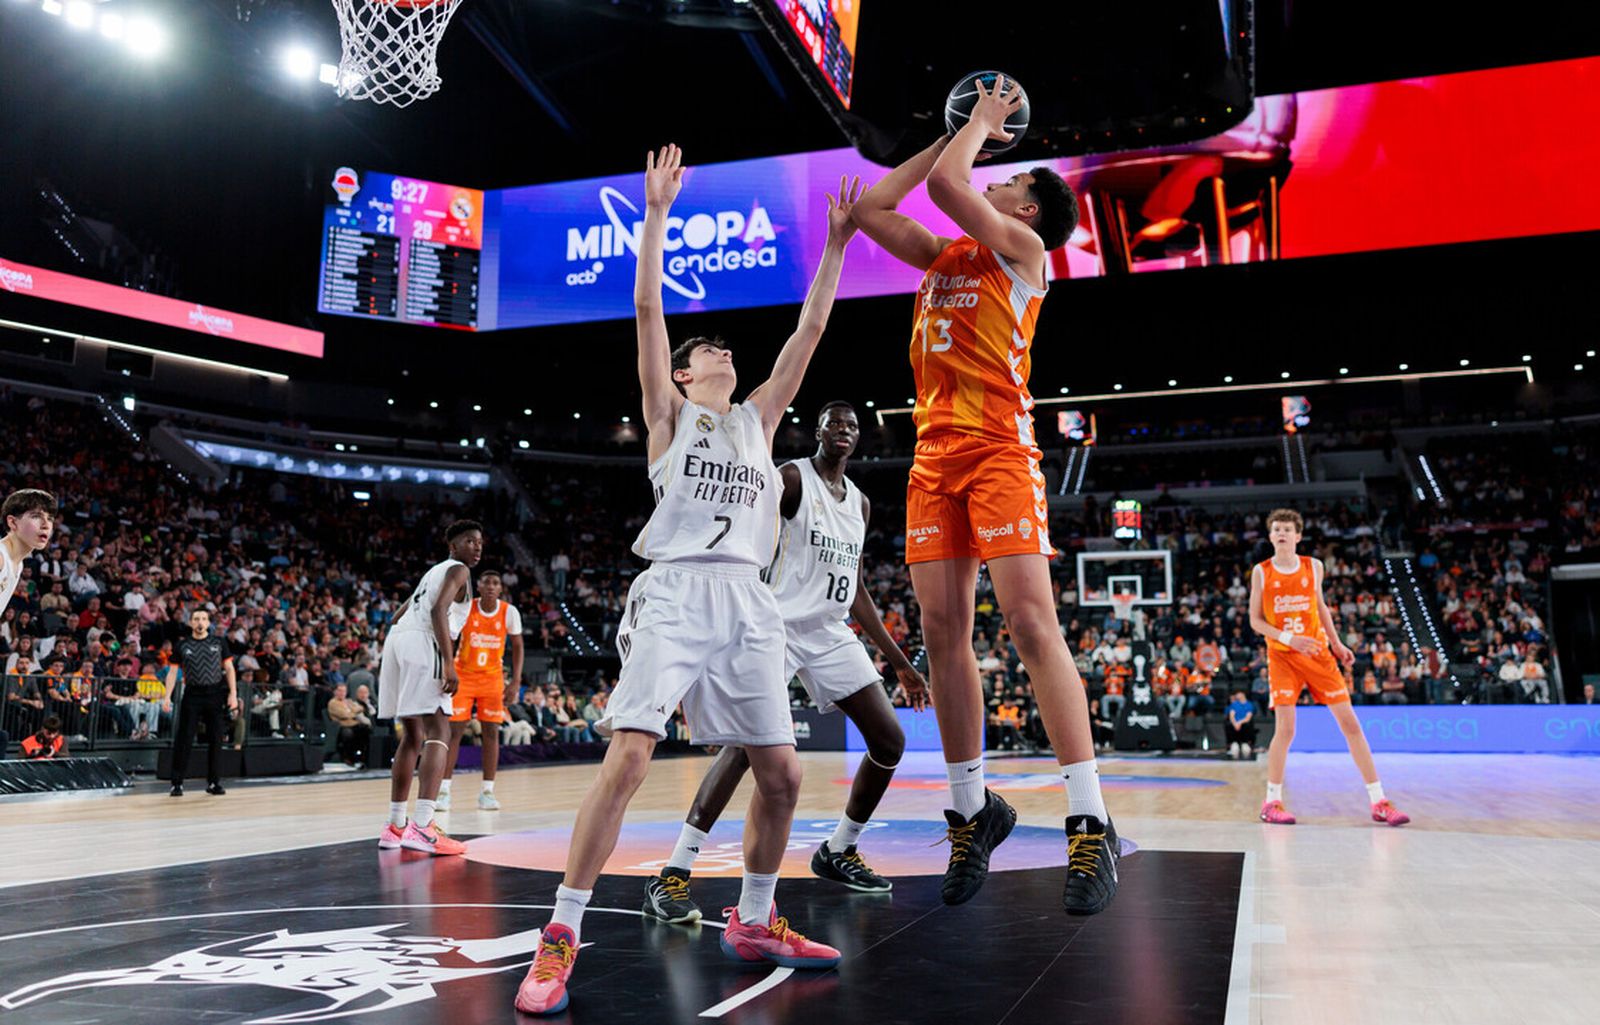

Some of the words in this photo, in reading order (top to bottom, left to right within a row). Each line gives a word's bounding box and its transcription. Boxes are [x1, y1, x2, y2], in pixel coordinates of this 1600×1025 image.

[391, 179, 429, 204] 9:27
[376, 214, 395, 234] 21
[566, 207, 776, 262] MINCOPA
[668, 246, 777, 276] endesa
[566, 270, 598, 286] acb
[922, 317, 953, 353] 13
[683, 454, 765, 491] Emirates
[694, 482, 719, 501] FLY
[720, 484, 758, 509] BETTER
[705, 515, 732, 550] 7
[810, 530, 861, 556] Emirat
[818, 549, 835, 563] FLY
[836, 553, 858, 571] BETTE
[826, 572, 850, 603] 18
[1283, 616, 1305, 634] 26
[477, 652, 488, 667] 0
[1364, 712, 1479, 741] ndesa
